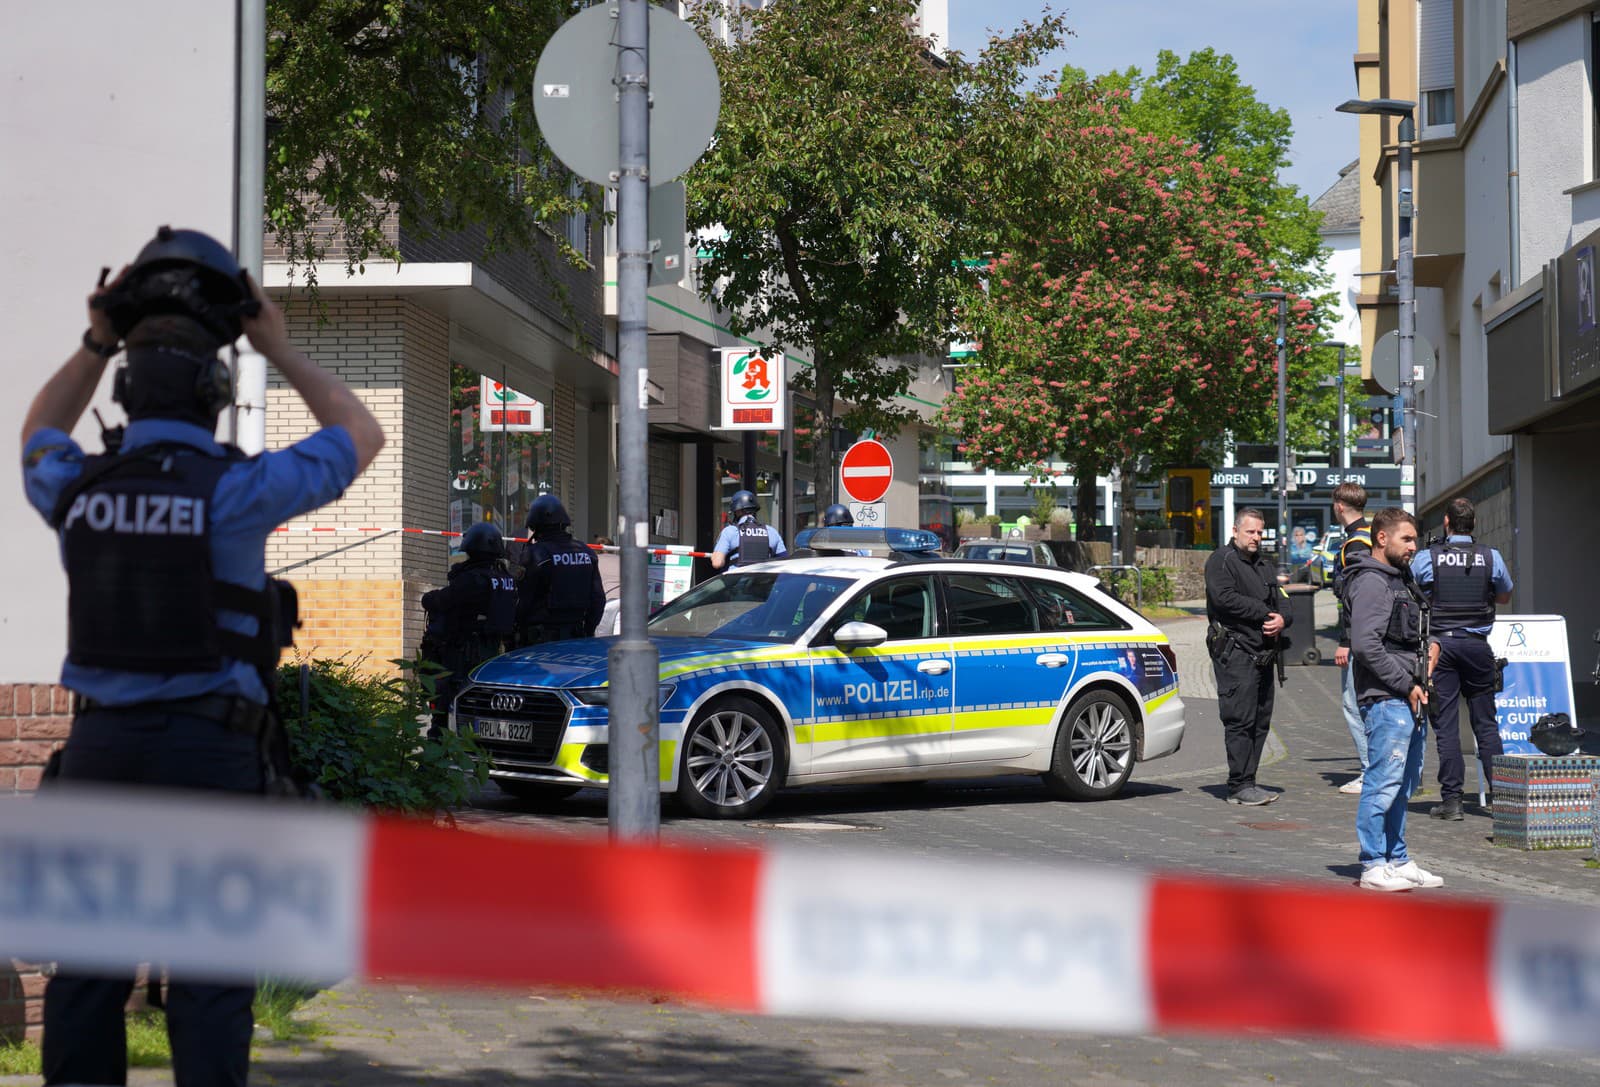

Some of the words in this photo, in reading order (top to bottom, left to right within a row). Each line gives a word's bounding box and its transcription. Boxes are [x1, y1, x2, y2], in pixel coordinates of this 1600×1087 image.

[1261, 469, 1317, 485] KD
[64, 493, 205, 536] POLIZEI
[739, 528, 768, 537] POLIZE
[1437, 553, 1486, 567] POLIEI
[816, 679, 950, 706] www.POLIZEI.rlp.de
[1494, 695, 1548, 708] ezialist
[479, 721, 495, 737] RPL
[508, 724, 531, 740] 8227
